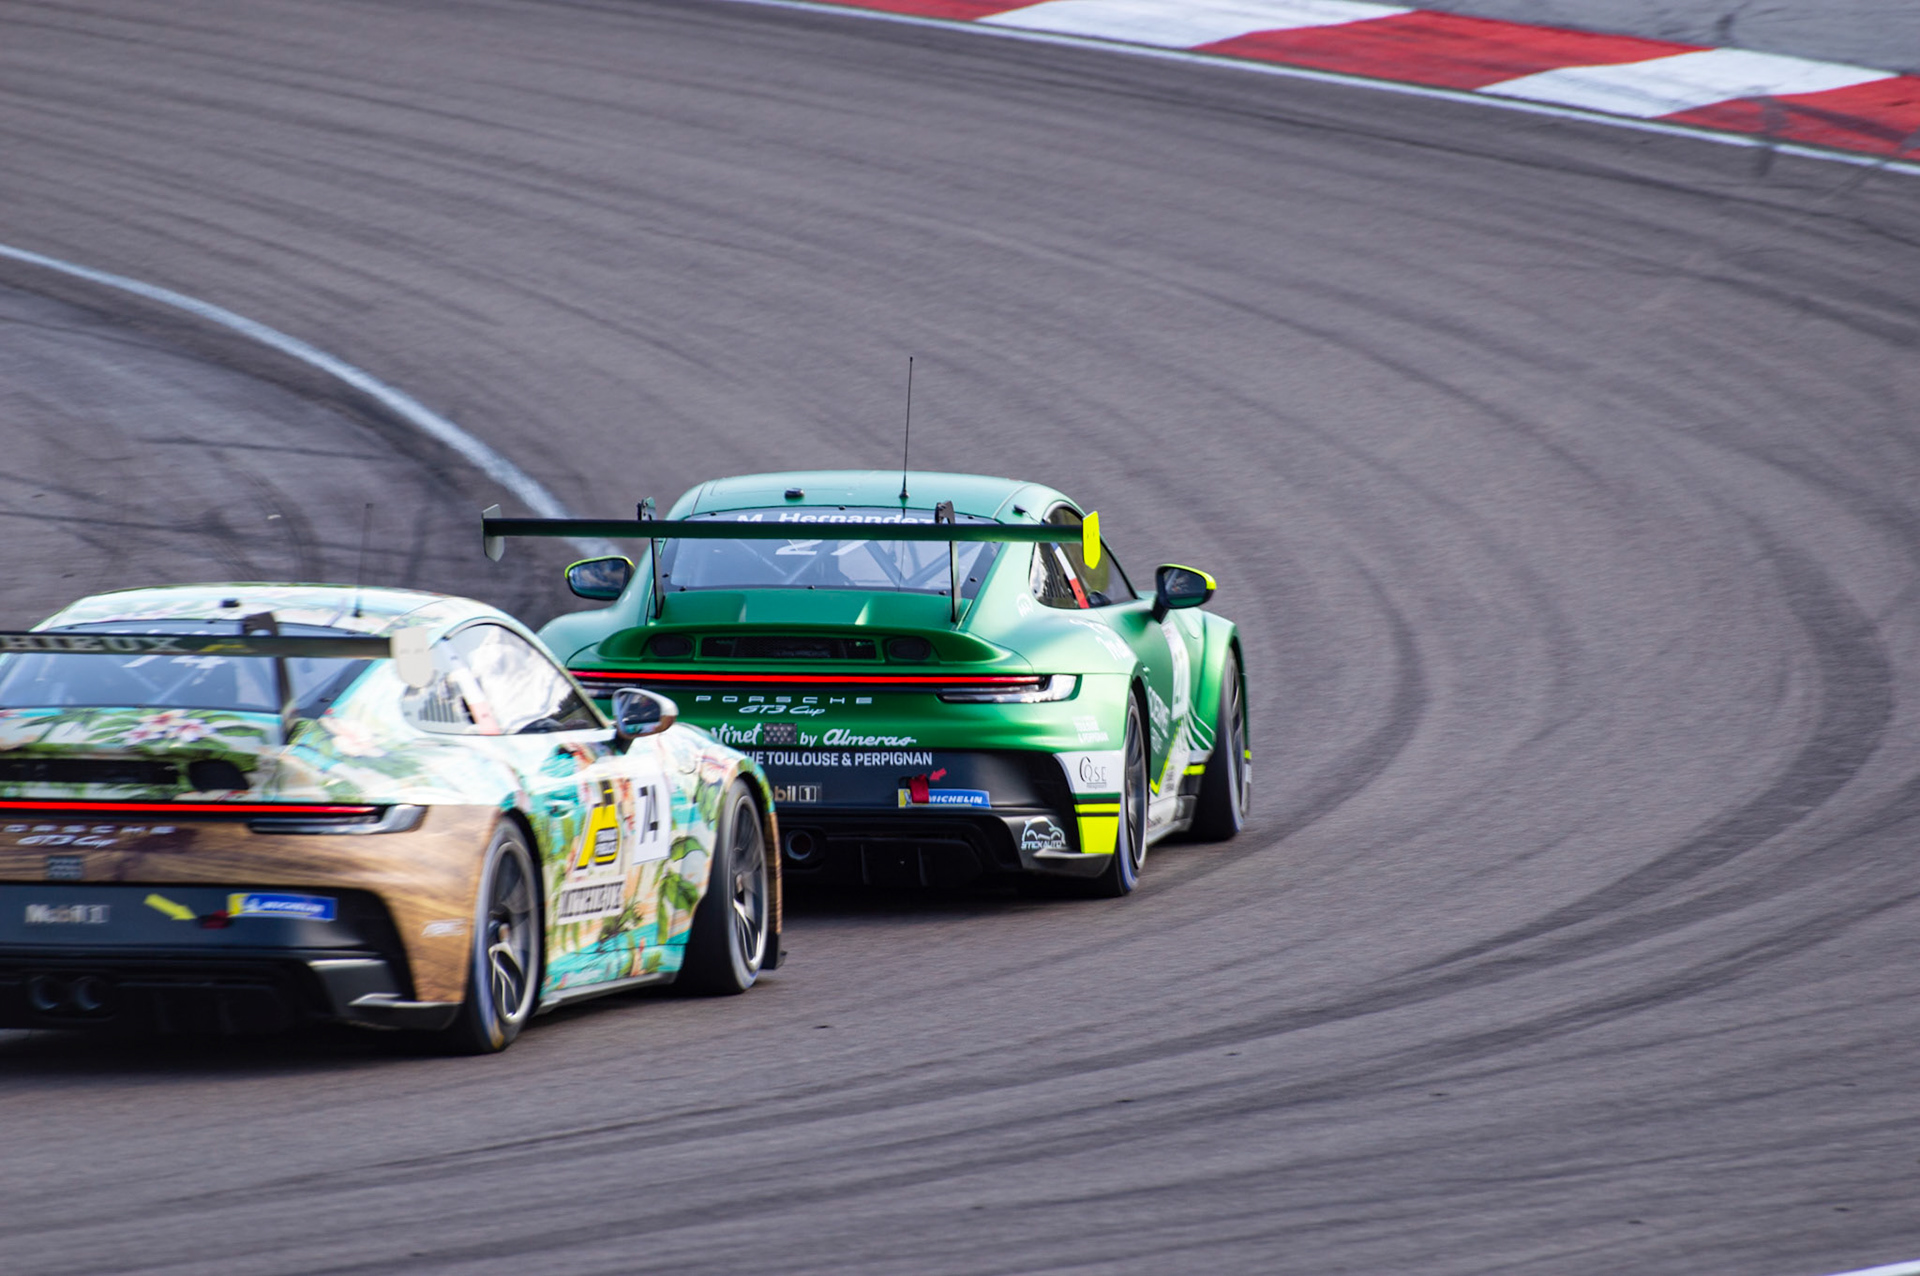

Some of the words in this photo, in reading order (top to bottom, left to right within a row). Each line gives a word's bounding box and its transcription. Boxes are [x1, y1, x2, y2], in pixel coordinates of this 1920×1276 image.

[695, 695, 873, 704] PORSCHE
[738, 704, 787, 714] GT3
[789, 705, 826, 716] Cup
[800, 732, 818, 748] by
[766, 752, 839, 766] TOULOUSE
[842, 753, 853, 766] &
[854, 752, 933, 766] PERPIGNAN
[638, 783, 661, 846] 74
